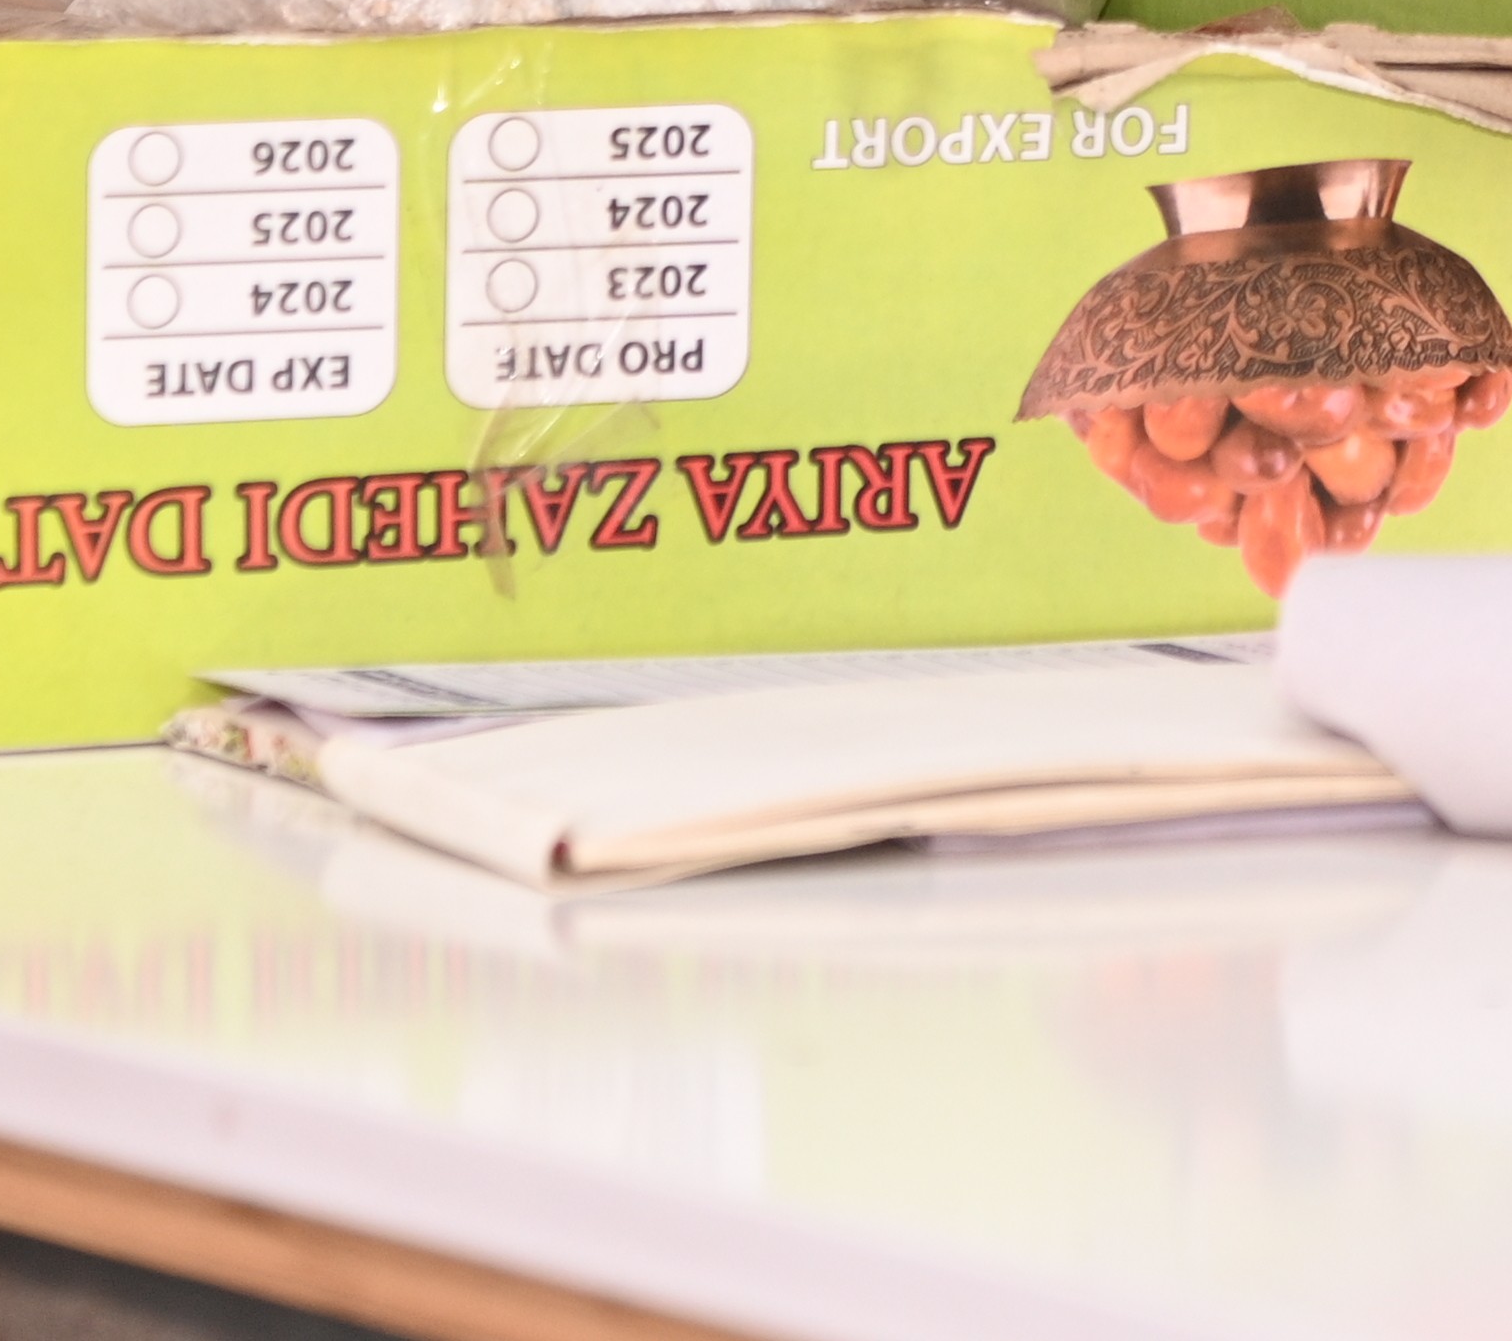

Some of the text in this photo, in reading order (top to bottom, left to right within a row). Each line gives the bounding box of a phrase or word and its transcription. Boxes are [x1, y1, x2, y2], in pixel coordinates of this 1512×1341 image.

[252, 137, 357, 174] 2026
[609, 123, 712, 161] 2025
[811, 103, 1190, 173] FOR EXPORT
[252, 208, 355, 245] 2025
[608, 193, 709, 230] 2024
[250, 278, 353, 314] 2024
[608, 263, 708, 300] 2023
[147, 354, 351, 398] EXP DATE
[496, 337, 705, 382] PRO DATE
[678, 436, 996, 548] ARIYA
[237, 457, 662, 573] ZAHEDI
